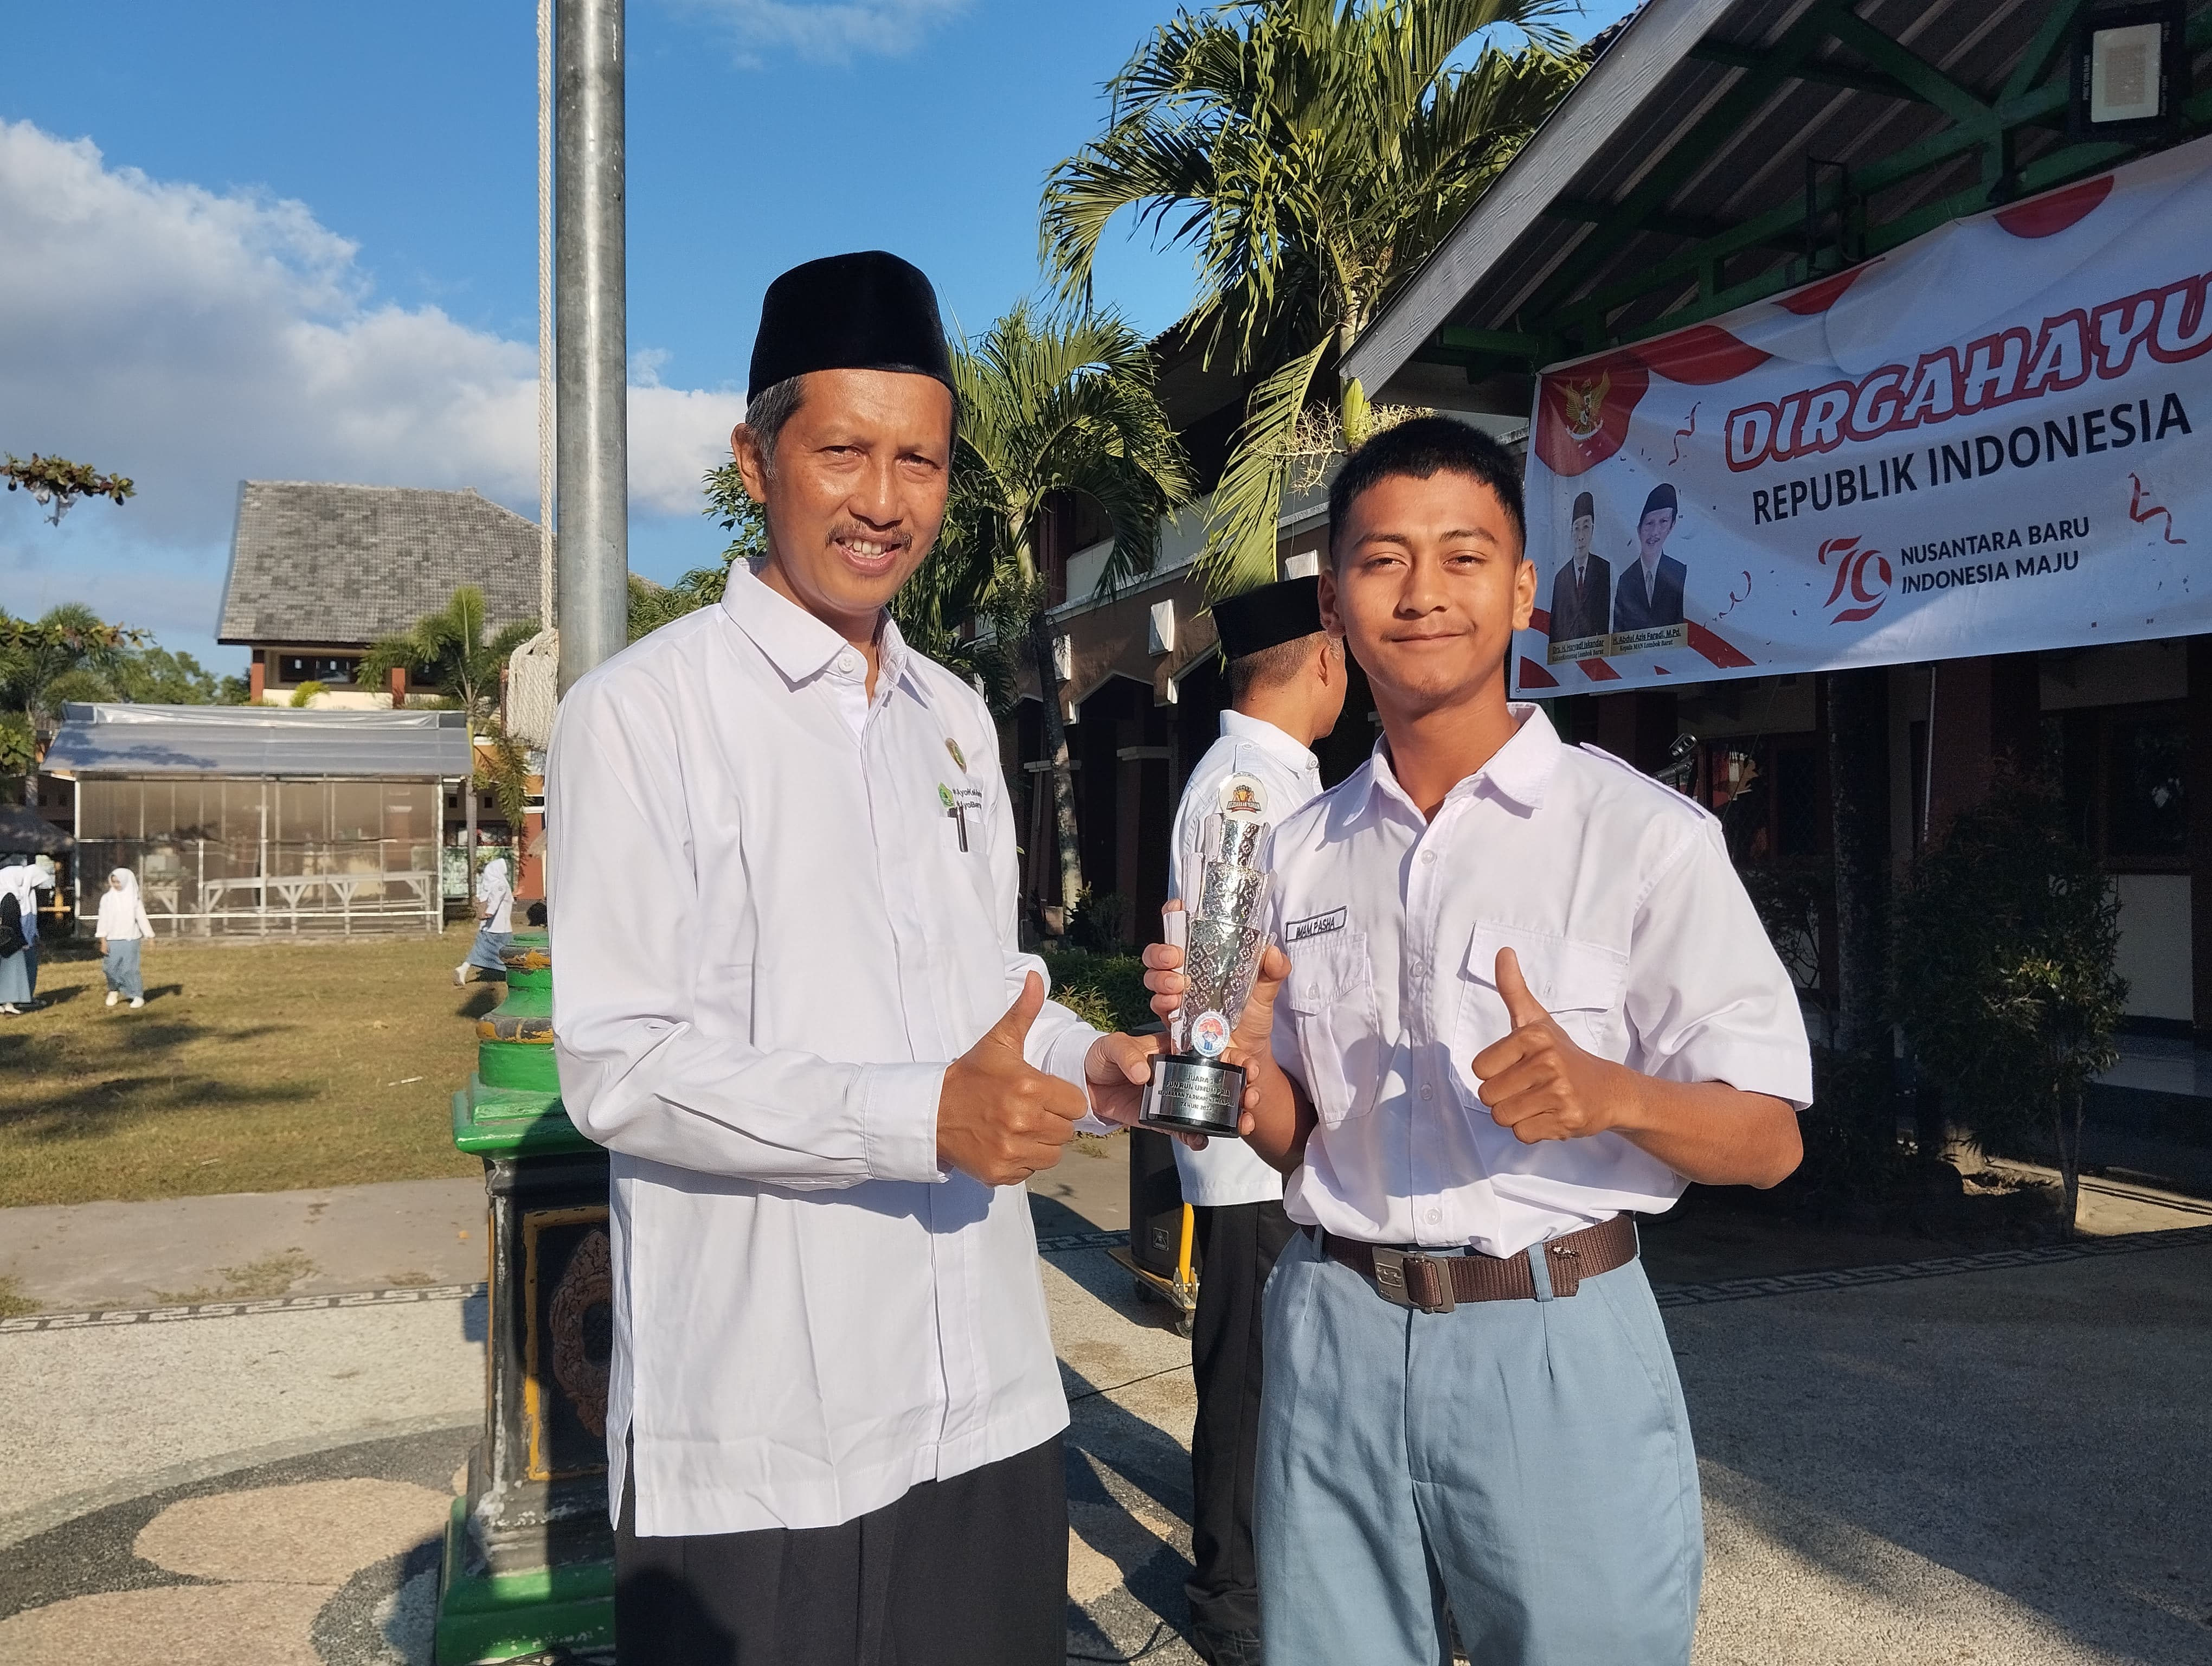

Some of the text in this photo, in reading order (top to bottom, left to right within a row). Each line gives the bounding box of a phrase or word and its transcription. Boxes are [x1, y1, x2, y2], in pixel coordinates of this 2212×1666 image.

[1725, 270, 2212, 472] DIRGAHAYU
[1752, 392, 2192, 525] REPUBLIK INDONESIA
[1900, 516, 2090, 566] NUSANTARA BARU
[1818, 535, 1892, 625] 79
[1902, 550, 2080, 594] INDONESIA MAJU
[1619, 634, 1635, 643] Abdul
[1635, 632, 1647, 641] Azis
[1666, 627, 1681, 638] M.Pd.
[1584, 639, 1604, 649] Iskandar
[1619, 644, 1633, 653] Kepala
[1643, 640, 1661, 649] Lombok
[1314, 917, 1335, 934] PASHA
[1186, 1074, 1210, 1084] JUARA
[1179, 1082, 1193, 1091] RUN
[1194, 1084, 1217, 1094] UMUM
[1217, 1087, 1231, 1098] PRIA
[1180, 1101, 1199, 1110] TAHUN
